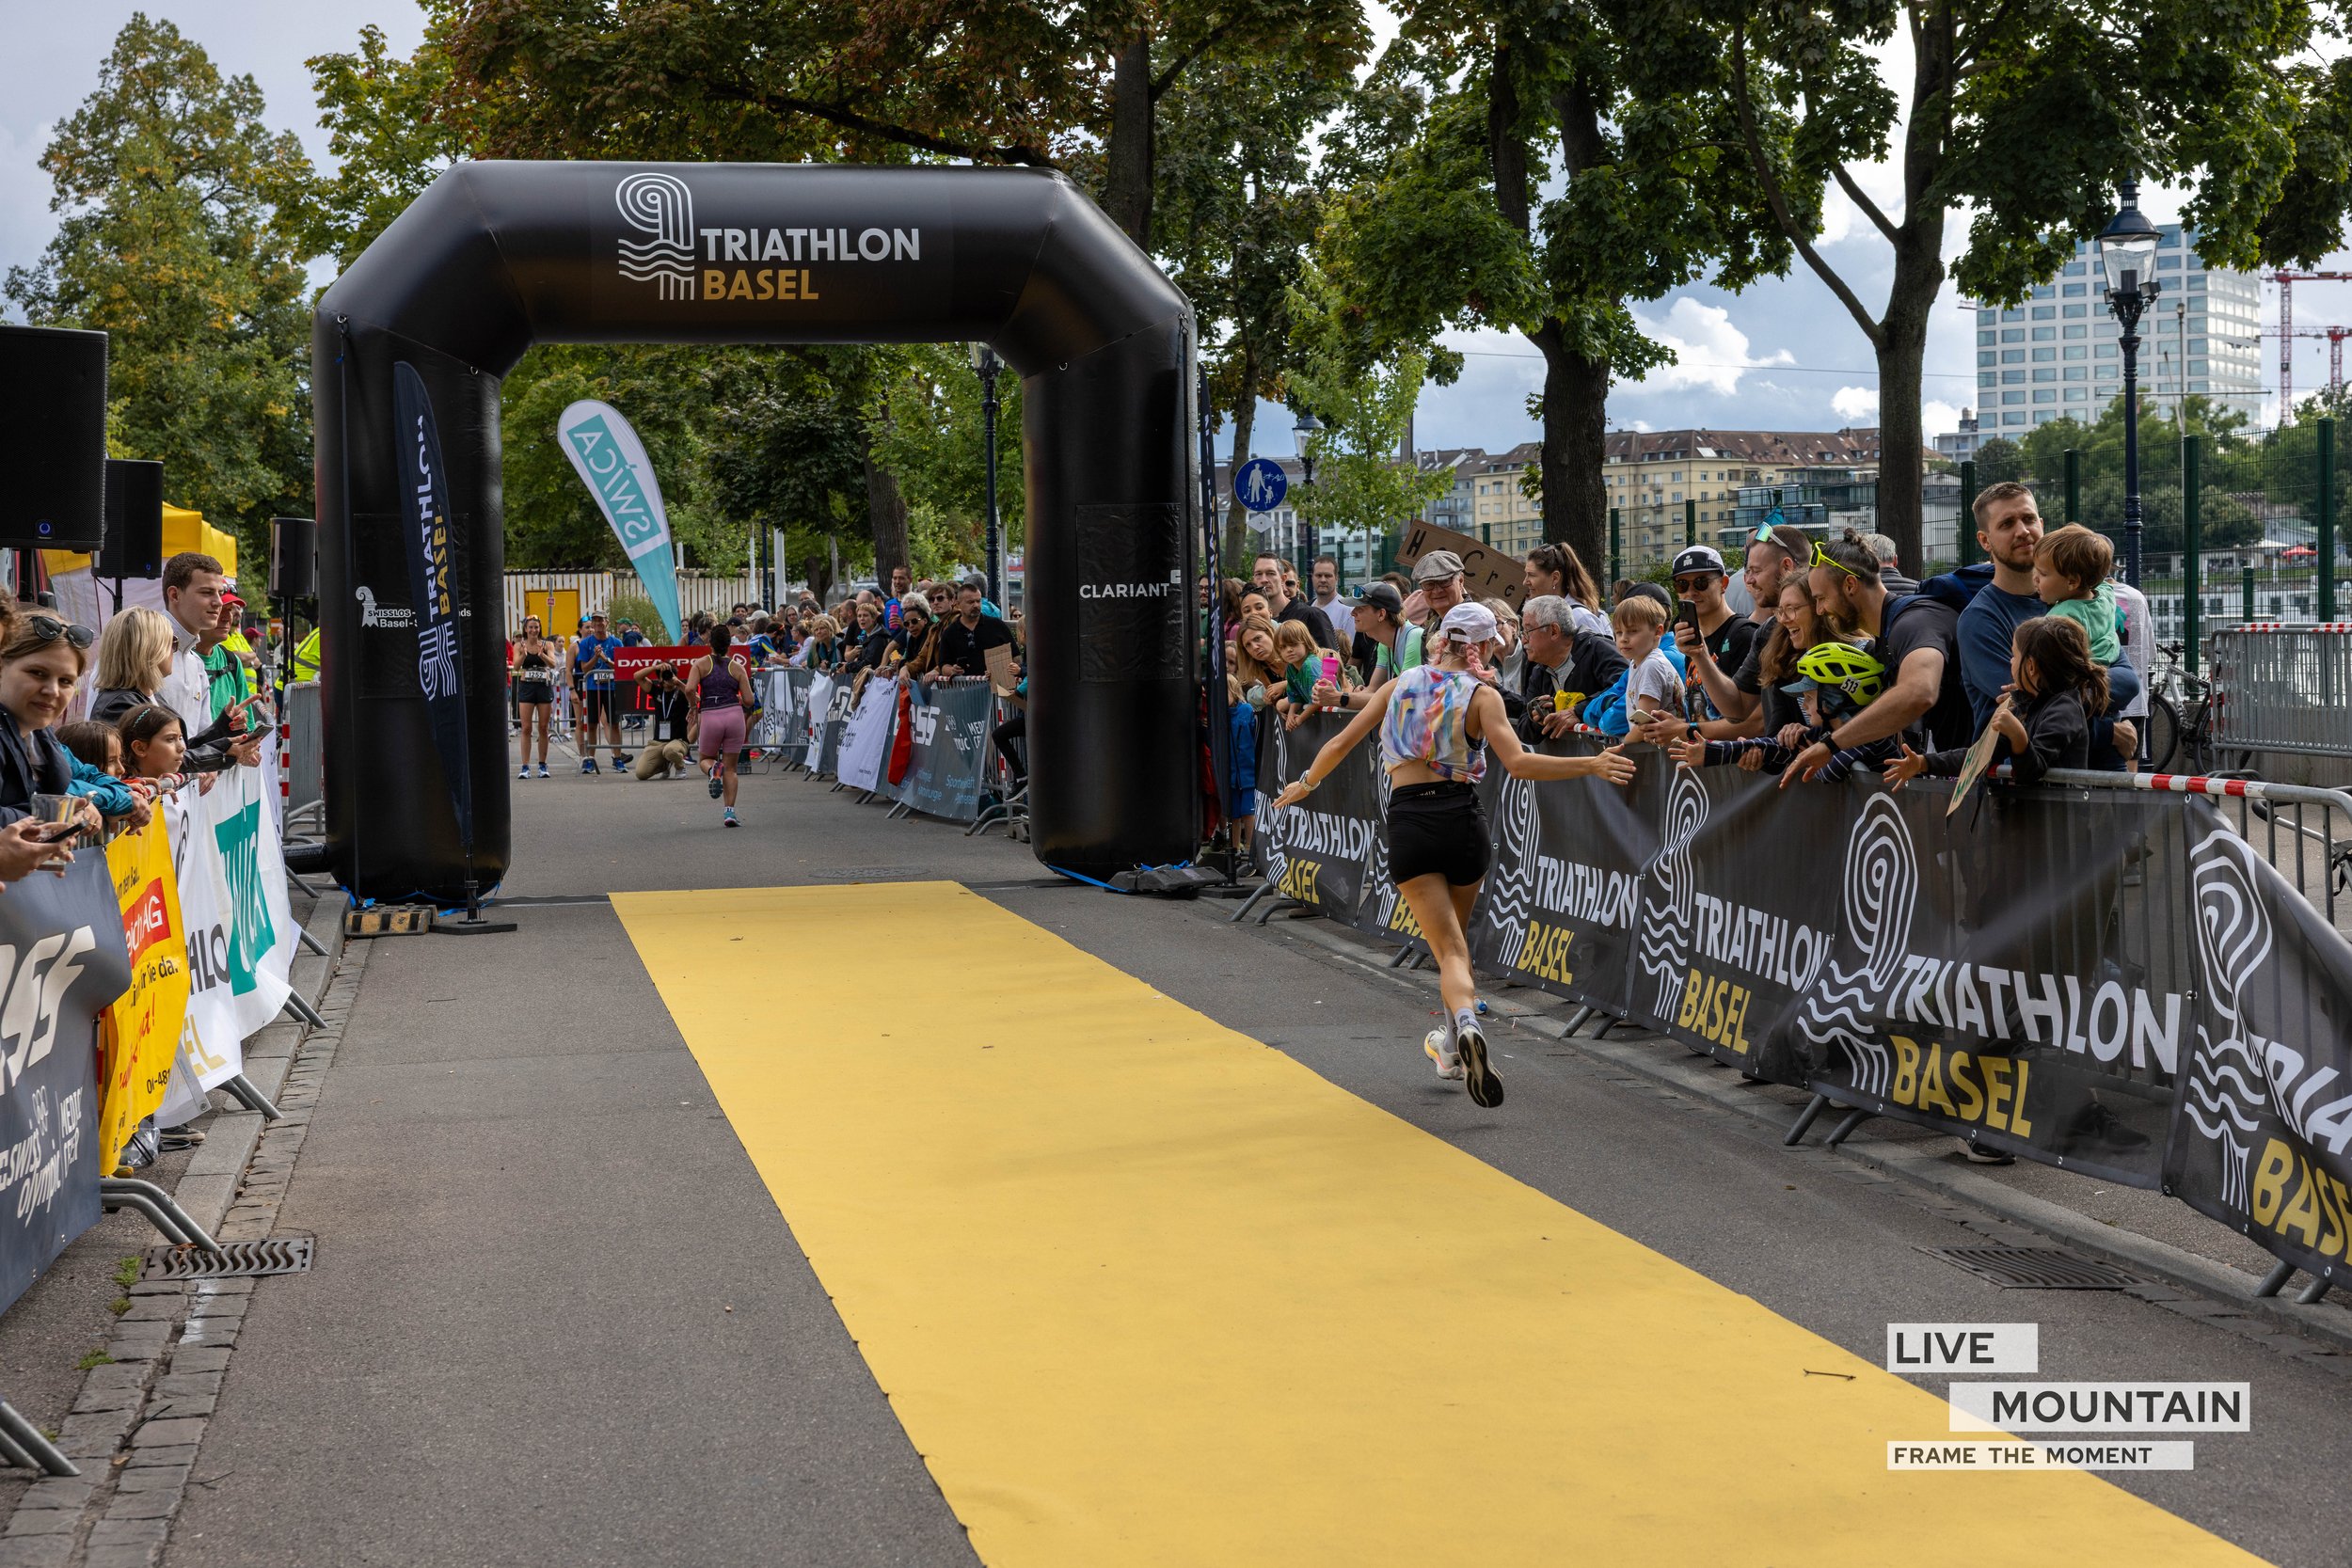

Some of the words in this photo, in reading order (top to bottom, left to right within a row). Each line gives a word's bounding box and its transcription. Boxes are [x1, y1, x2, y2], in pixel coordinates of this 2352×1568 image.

[701, 228, 920, 261] TRIATHLON
[704, 269, 819, 300] BASEL
[1079, 582, 1169, 599] CLARIANT
[1842, 678, 1859, 694] 513
[1286, 805, 1375, 863] TRIATHLON
[1535, 854, 1640, 930] TRIATHLON
[1517, 920, 1575, 986] BASEL
[1694, 892, 1831, 994] TRIATHLON
[1678, 968, 1752, 1054] BASEL
[1886, 954, 2182, 1075] TRIATHLON
[1889, 1035, 2032, 1138] BASEL
